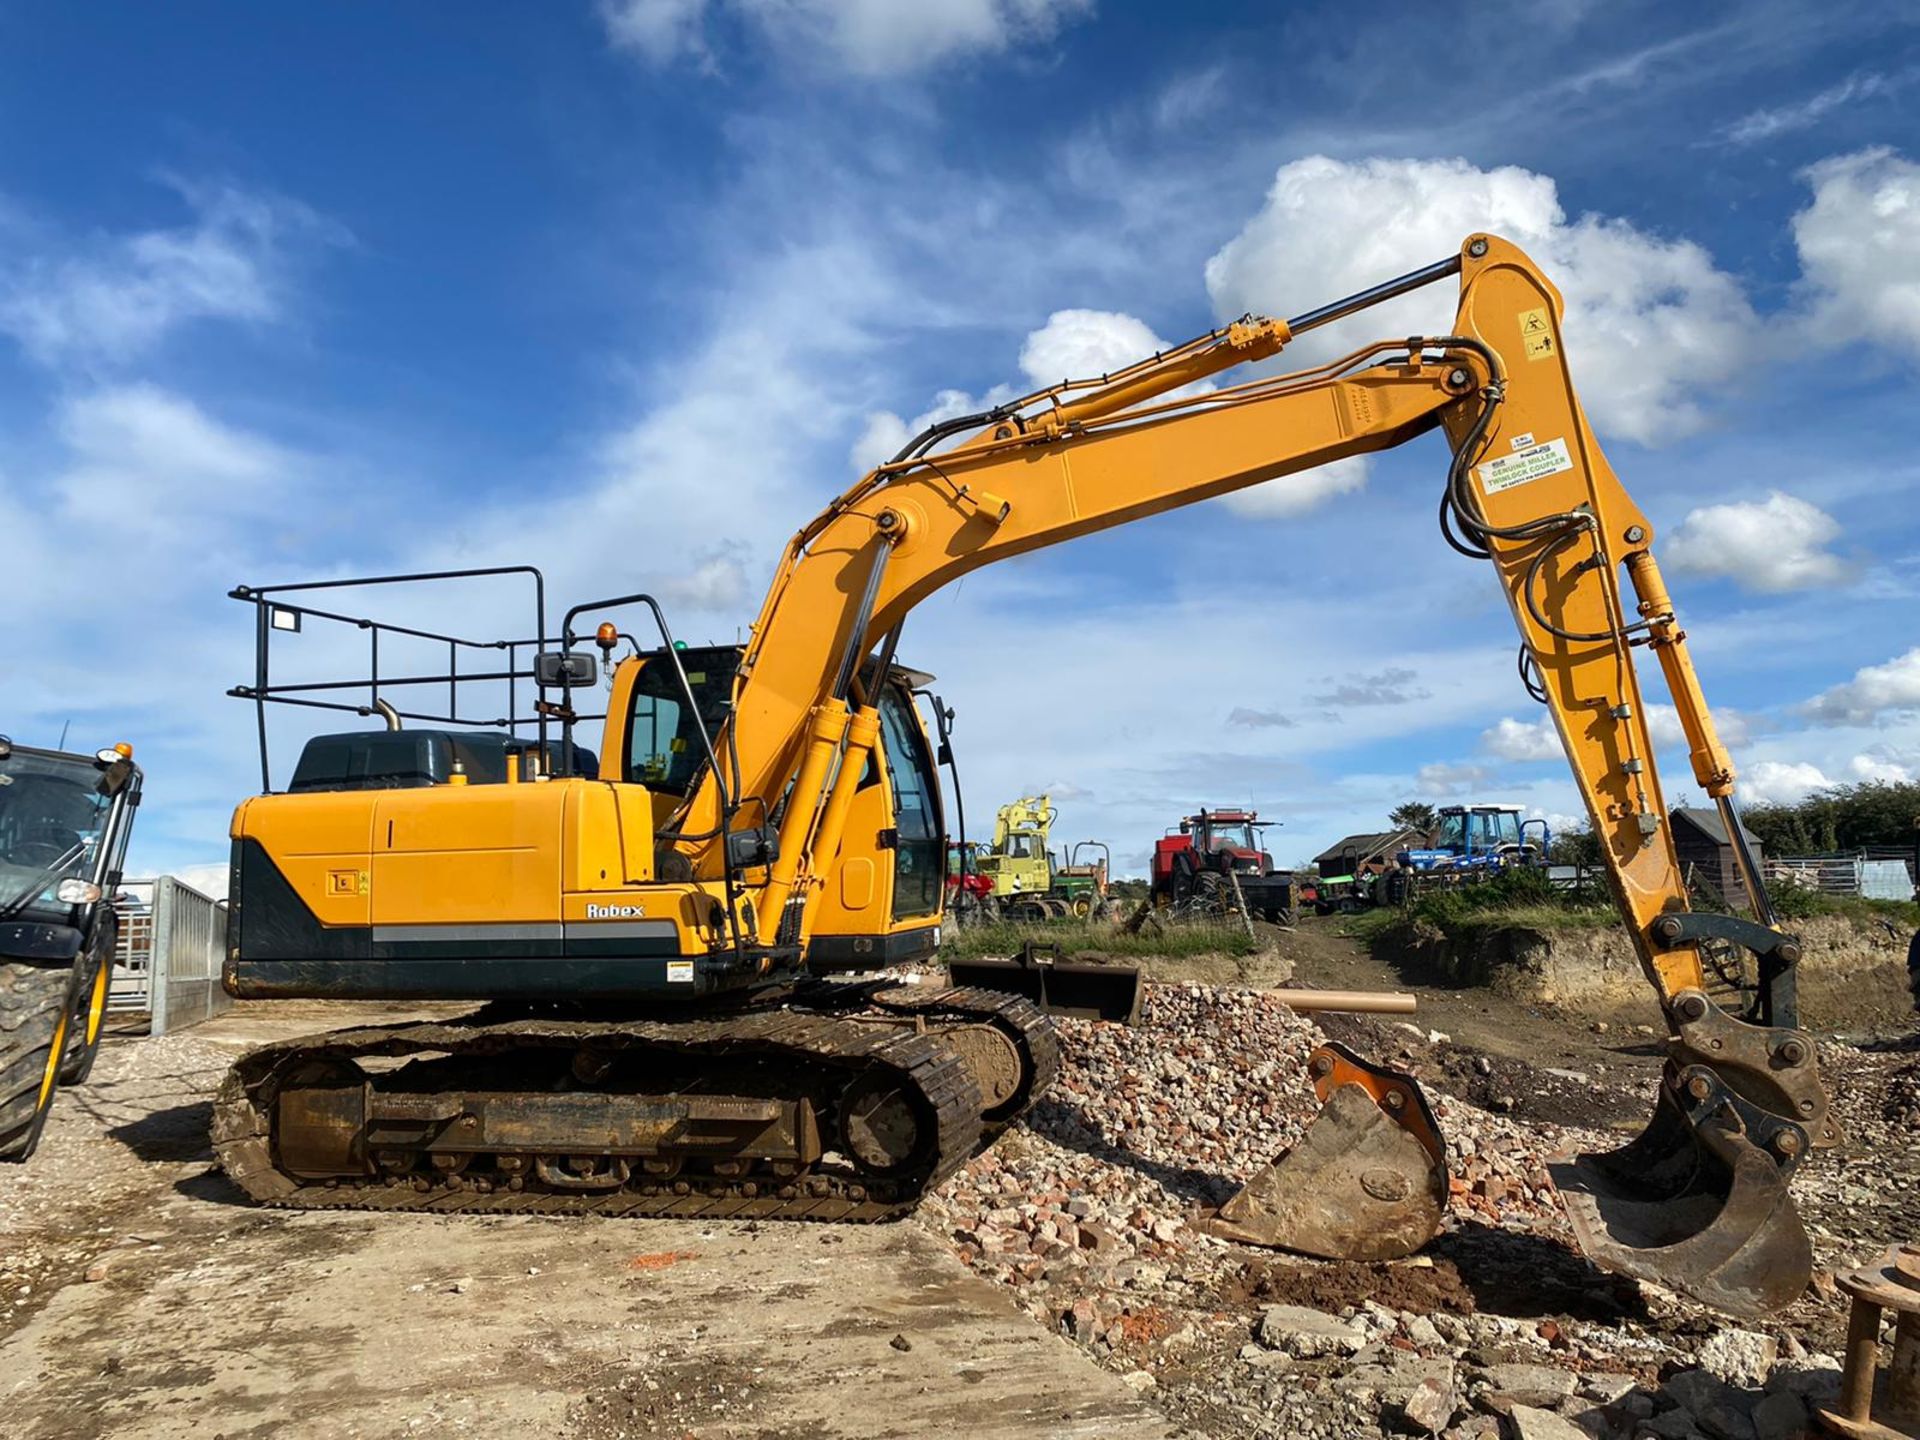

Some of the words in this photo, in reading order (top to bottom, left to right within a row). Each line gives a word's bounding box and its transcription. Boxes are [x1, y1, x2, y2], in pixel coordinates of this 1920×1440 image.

[1488, 468, 1528, 486] TWINLOCK
[1529, 457, 1566, 473] COUPLER
[1491, 460, 1527, 477] GENUINE
[1528, 451, 1557, 465] MILLER
[586, 903, 644, 919] Robex
